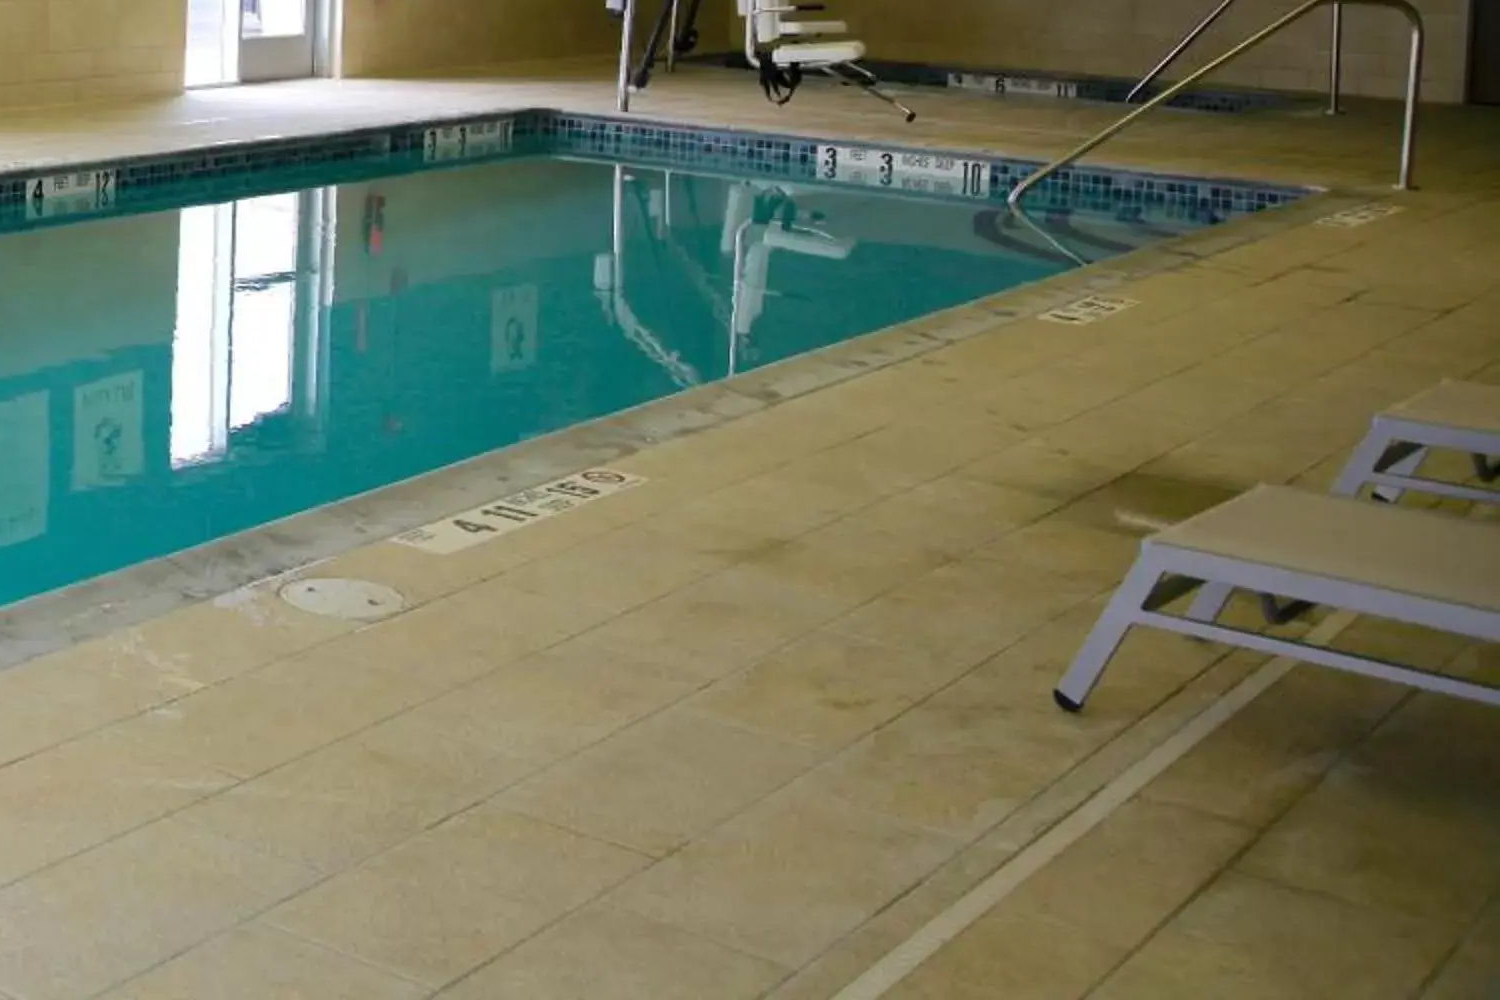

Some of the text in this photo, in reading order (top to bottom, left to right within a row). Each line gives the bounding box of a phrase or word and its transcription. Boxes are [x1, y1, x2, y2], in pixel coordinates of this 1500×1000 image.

[32, 179, 44, 198] 4
[452, 519, 498, 533] 4
[480, 505, 539, 522] 11
